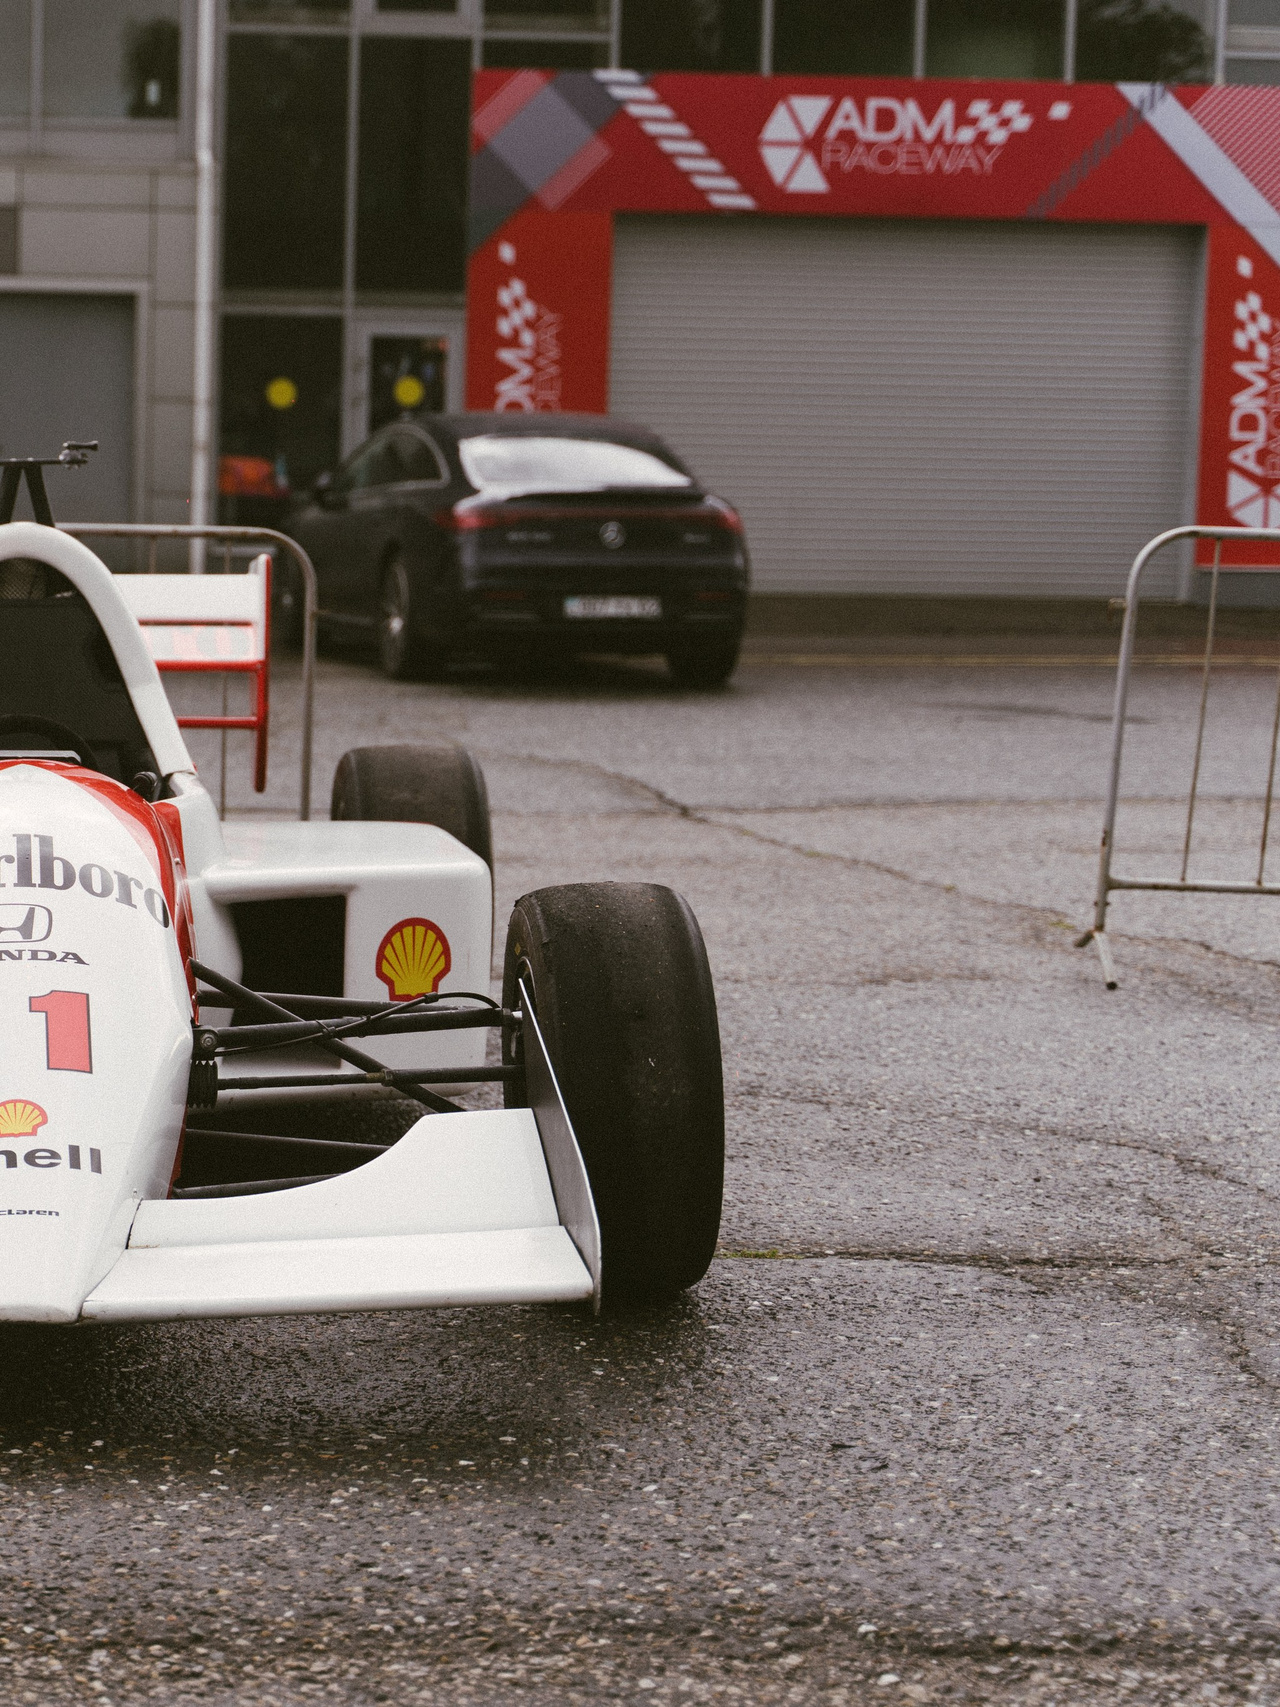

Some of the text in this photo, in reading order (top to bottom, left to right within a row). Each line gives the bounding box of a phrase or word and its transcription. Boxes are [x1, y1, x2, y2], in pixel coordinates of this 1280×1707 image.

[823, 95, 956, 144] ADM
[820, 141, 1004, 175] RACEWAY
[495, 347, 535, 412] DM
[1229, 360, 1268, 477] ADM
